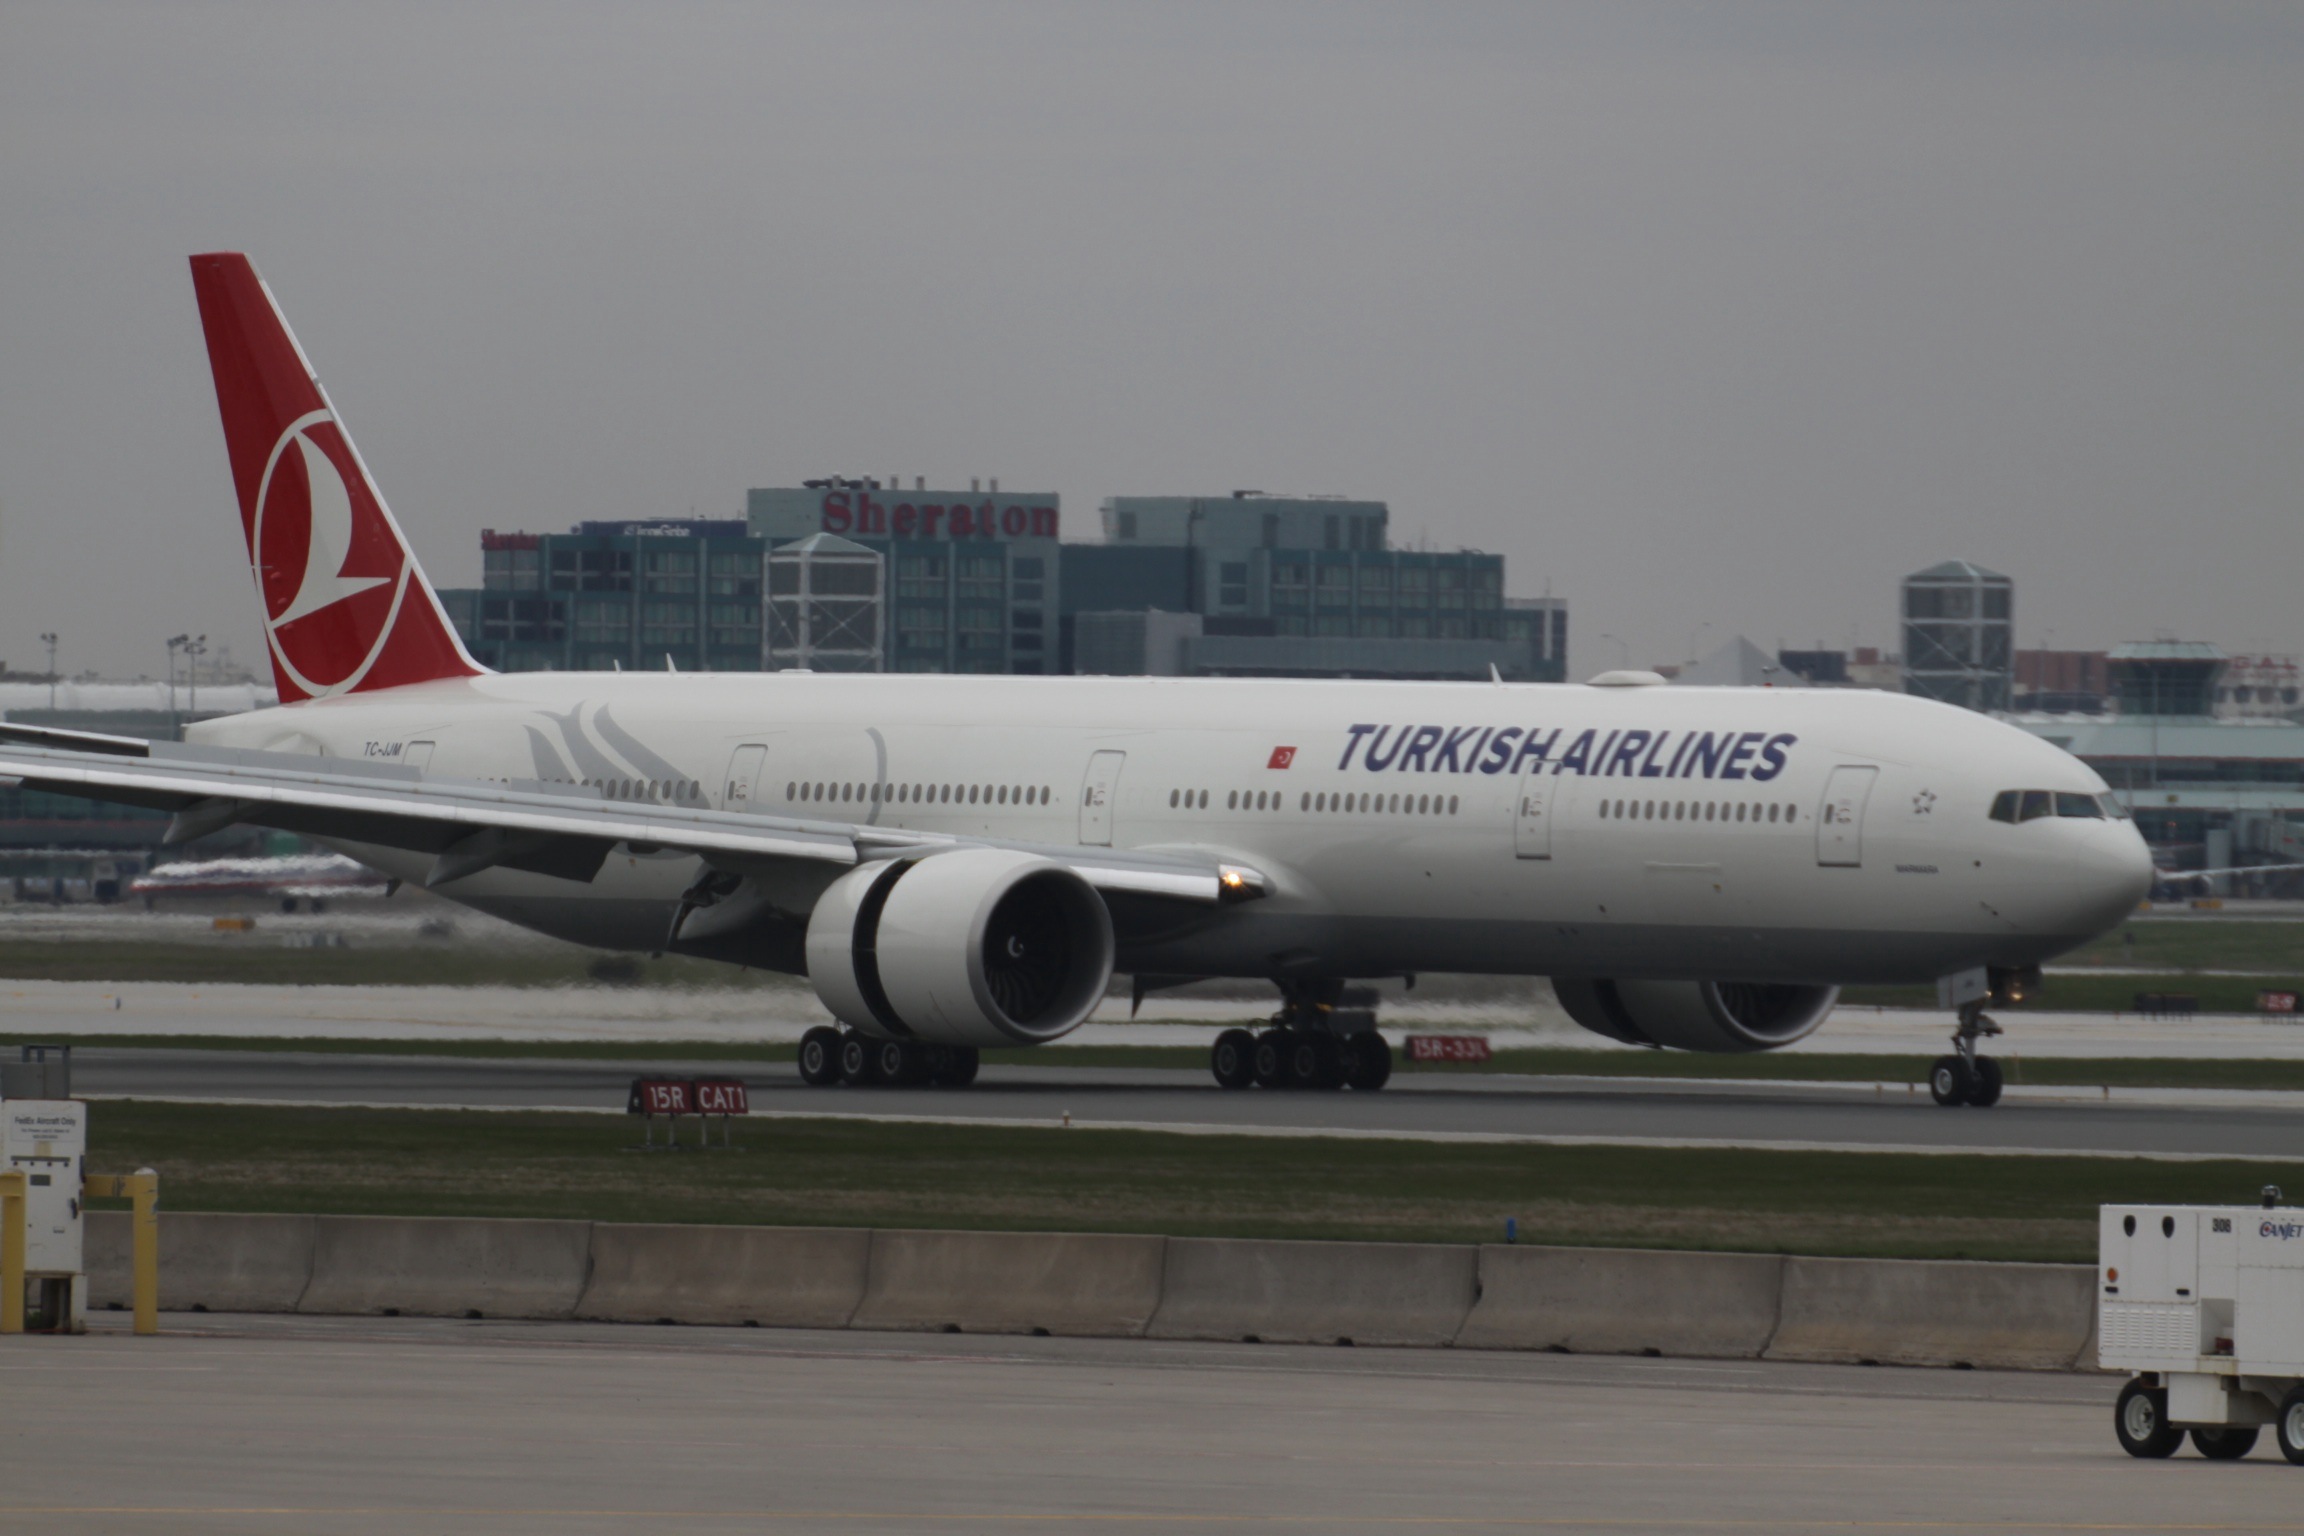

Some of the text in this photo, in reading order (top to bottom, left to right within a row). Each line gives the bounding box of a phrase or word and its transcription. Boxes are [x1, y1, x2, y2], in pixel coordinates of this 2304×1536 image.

[822, 491, 1058, 537] Sheraton
[364, 741, 403, 756] TC-JJM
[1338, 724, 1799, 781] TURKISH AIRLINES
[1413, 1038, 1486, 1058] 15R-33L
[649, 1086, 685, 1109] 15R
